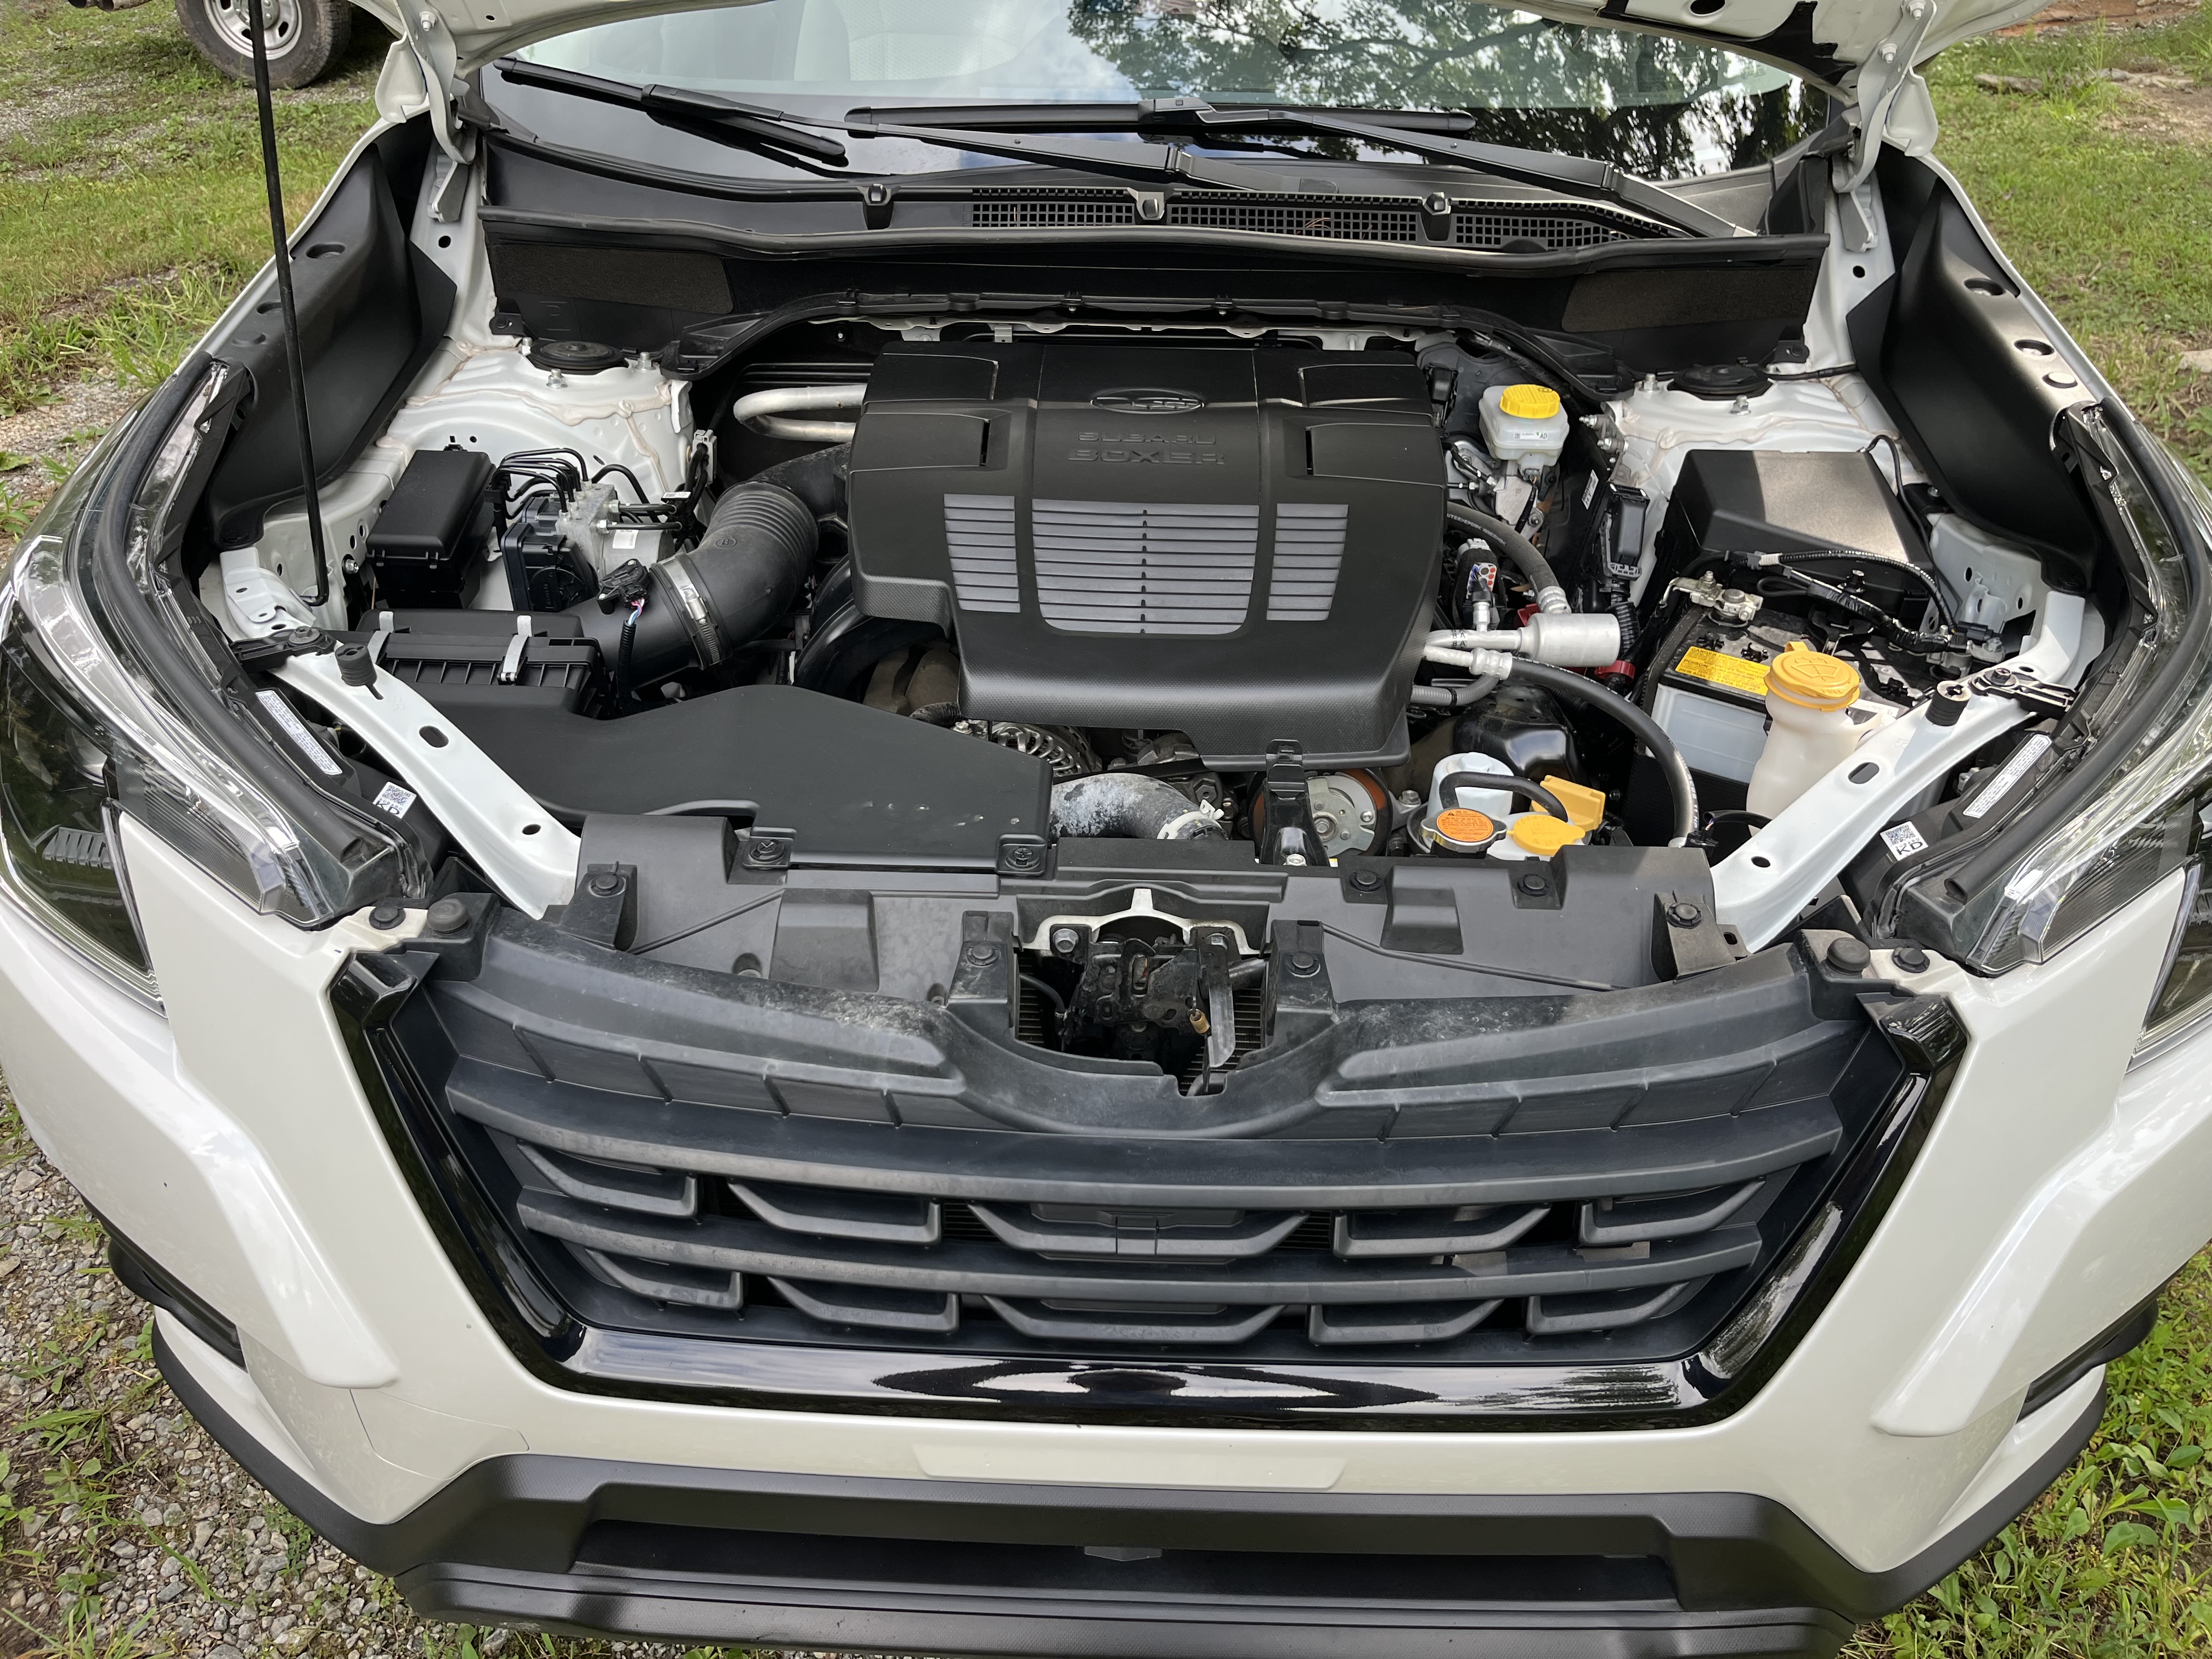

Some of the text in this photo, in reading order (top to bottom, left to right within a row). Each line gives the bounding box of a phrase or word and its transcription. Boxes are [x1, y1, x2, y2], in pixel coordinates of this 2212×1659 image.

[1077, 432, 1216, 445] SUBARU
[1068, 449, 1224, 465] BOXER
[1690, 647, 1717, 656] DANGER
[1683, 658, 1708, 668] POISON
[1896, 841, 1923, 856] KD
